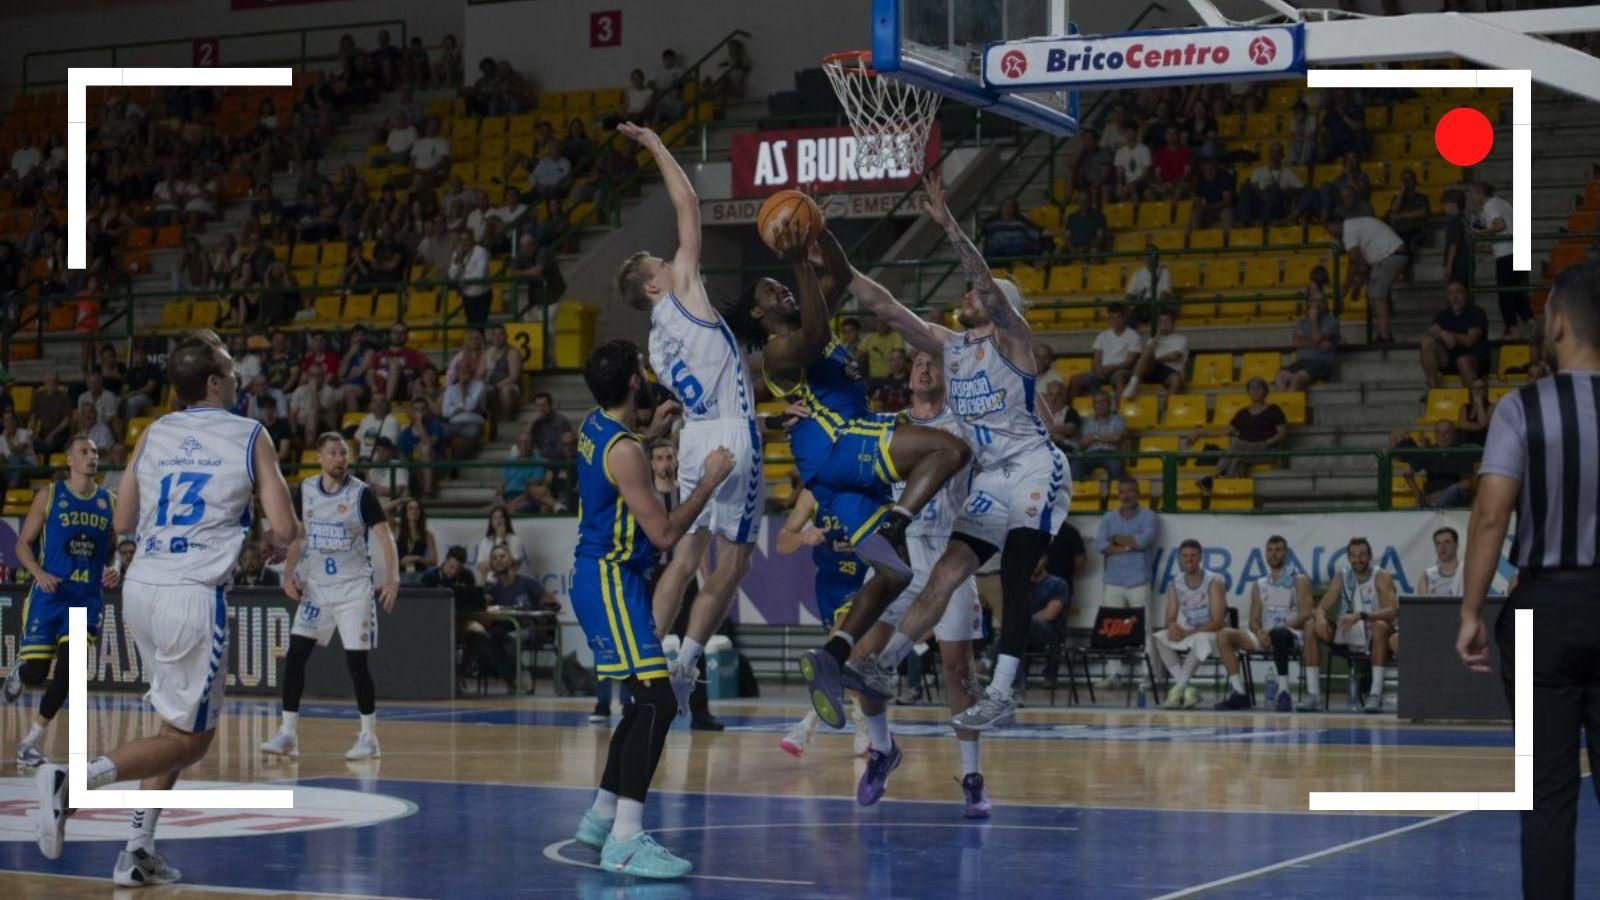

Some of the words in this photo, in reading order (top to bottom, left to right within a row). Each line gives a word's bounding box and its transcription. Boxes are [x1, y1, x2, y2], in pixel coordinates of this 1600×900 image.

[597, 16, 613, 42] 3
[199, 43, 214, 67] 2
[1046, 43, 1230, 73] BricoCentro
[753, 139, 789, 187] AS
[713, 203, 761, 220] SAID
[852, 193, 930, 214] EMERXE
[514, 331, 531, 363] 3
[671, 359, 704, 407] 6
[156, 472, 213, 526] 13
[69, 568, 90, 584] 44
[325, 557, 337, 575] 8
